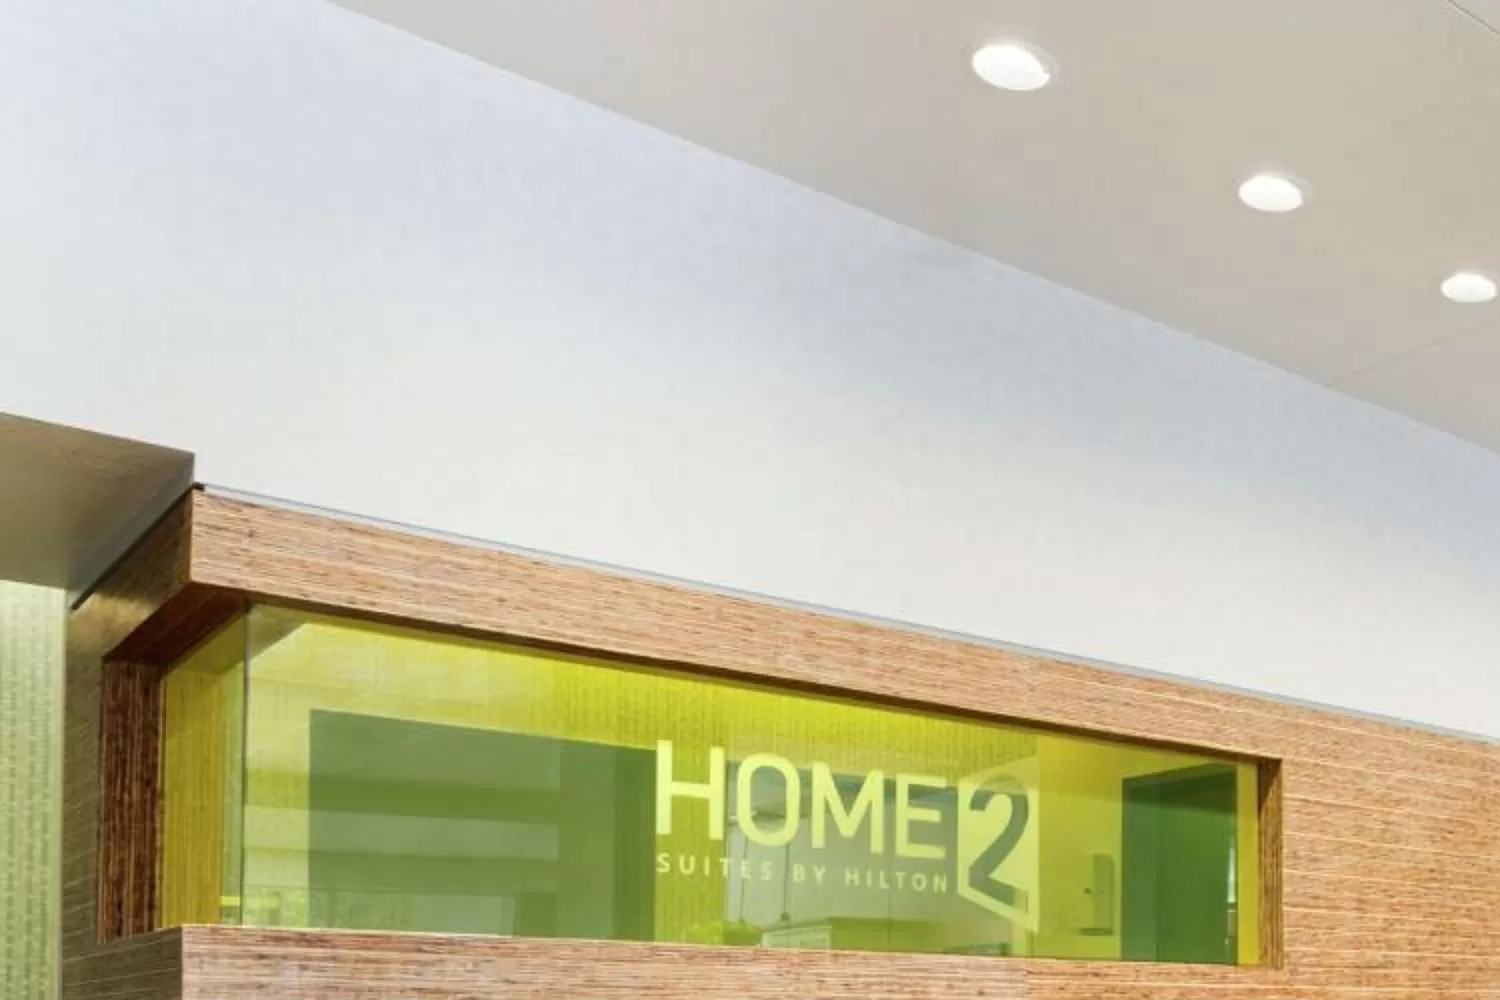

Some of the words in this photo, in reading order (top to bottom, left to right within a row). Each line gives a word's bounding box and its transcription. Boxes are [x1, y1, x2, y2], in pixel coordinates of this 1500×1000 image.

[656, 852, 773, 881] SUITES
[793, 863, 827, 884] BY
[844, 867, 948, 894] HILTON
